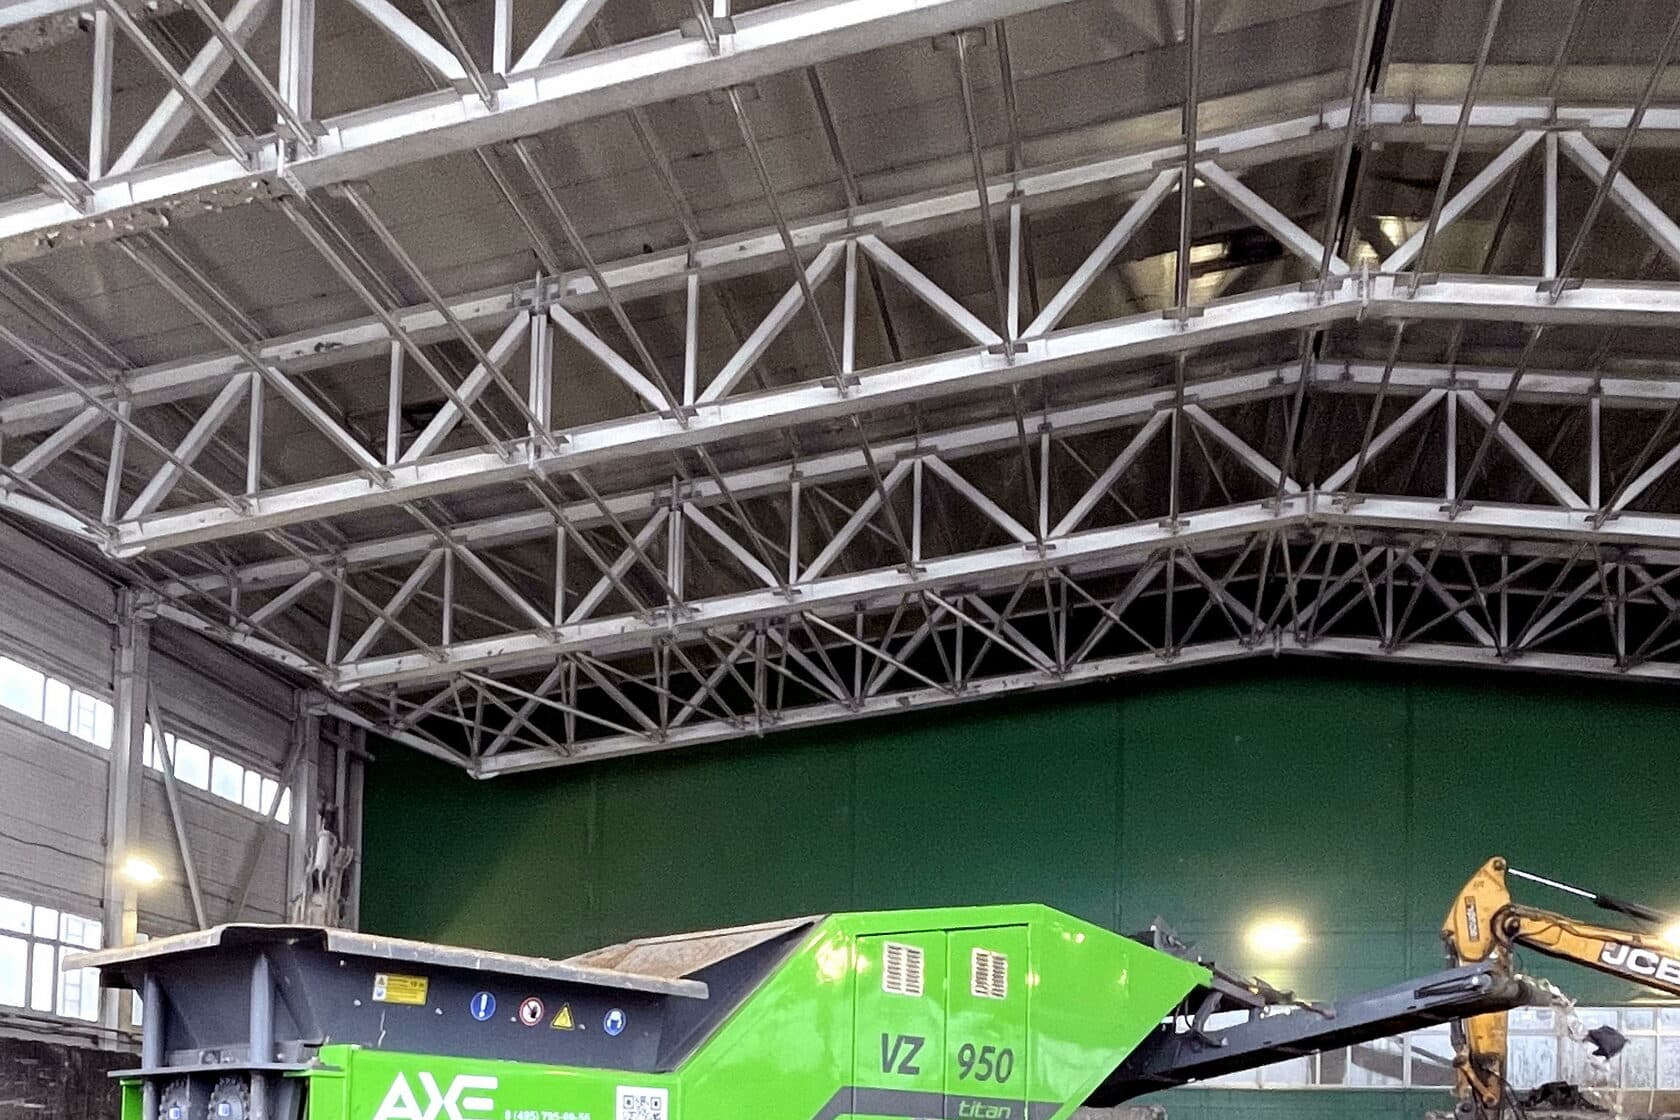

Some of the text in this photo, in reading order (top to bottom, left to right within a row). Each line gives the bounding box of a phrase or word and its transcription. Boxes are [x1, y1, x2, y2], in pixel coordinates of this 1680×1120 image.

[1601, 942, 1680, 985] JCB
[880, 1033, 1014, 1083] VZ 950
[958, 1100, 1011, 1119] titan
